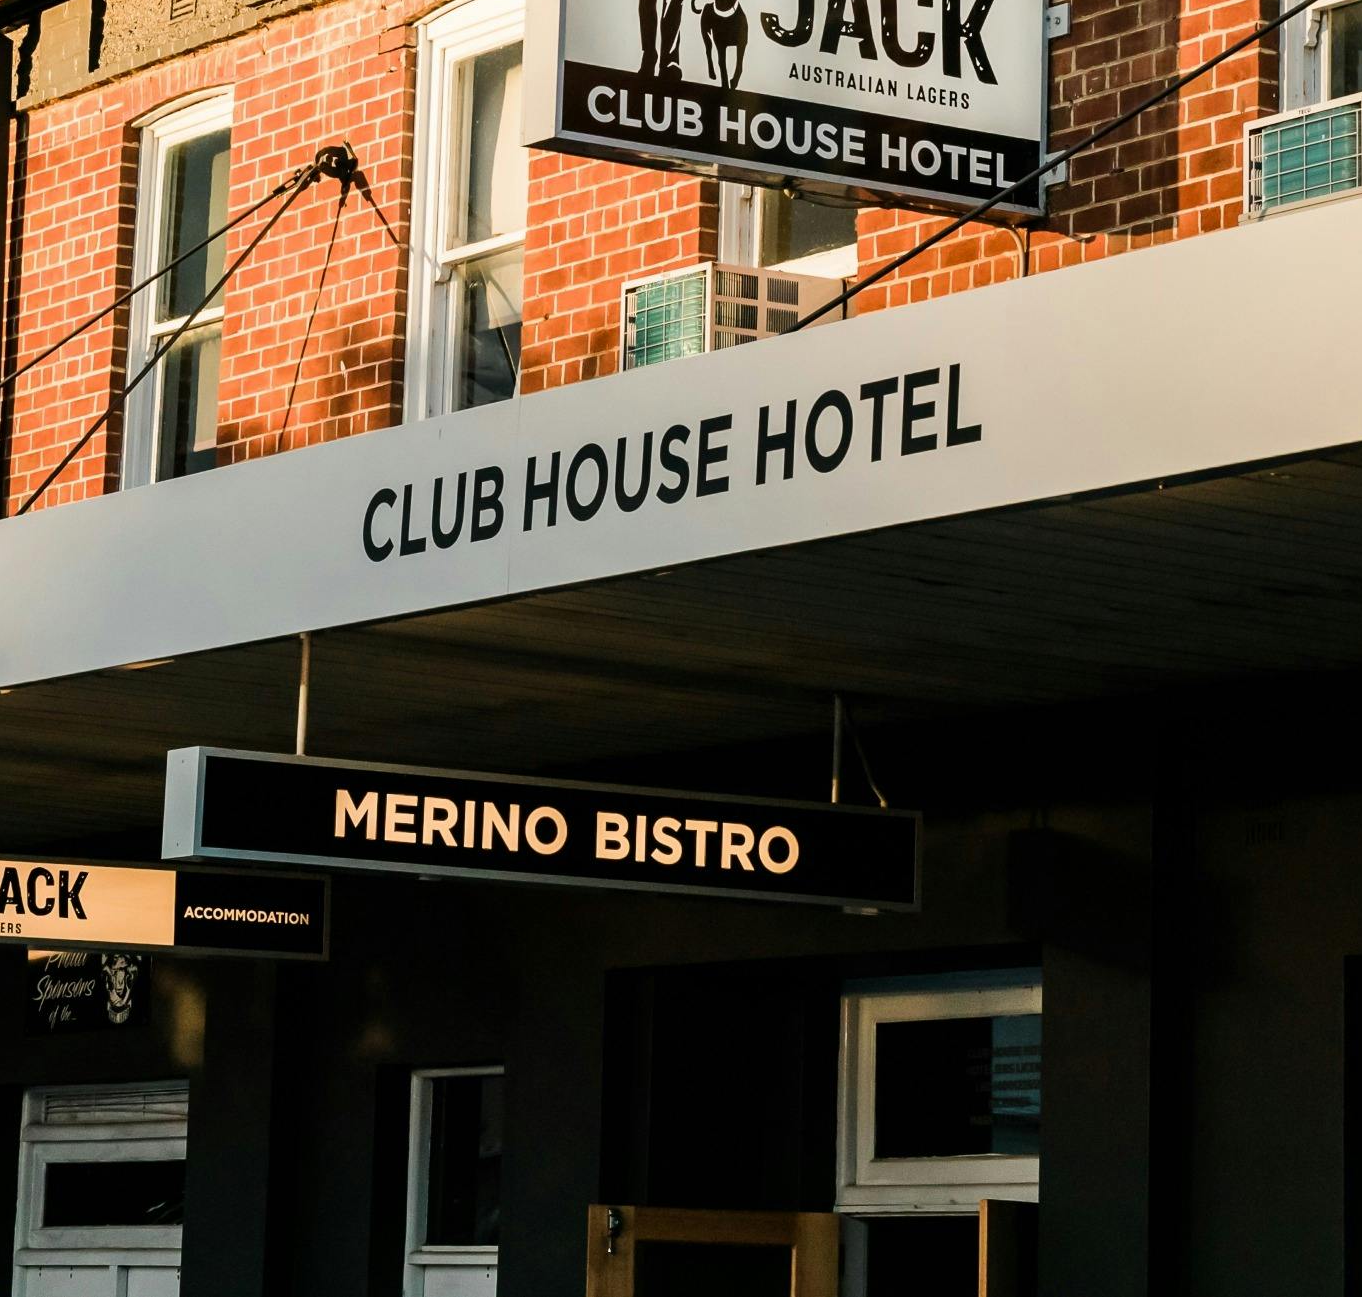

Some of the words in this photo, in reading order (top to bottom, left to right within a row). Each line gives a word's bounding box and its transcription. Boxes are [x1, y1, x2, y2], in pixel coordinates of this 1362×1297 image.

[788, 62, 898, 97] AUSTRALIAN
[906, 83, 970, 110] LAGERS
[587, 85, 704, 137] CLUB
[719, 107, 866, 165] HOUSE
[880, 133, 1018, 190] HOTEL
[362, 465, 505, 563] CLUB
[523, 413, 733, 532] HOUSE
[755, 363, 983, 486] HOTEL
[334, 789, 568, 855] MERINO
[595, 811, 799, 874] BISTRO
[184, 906, 310, 925] ACCOMMODATION
